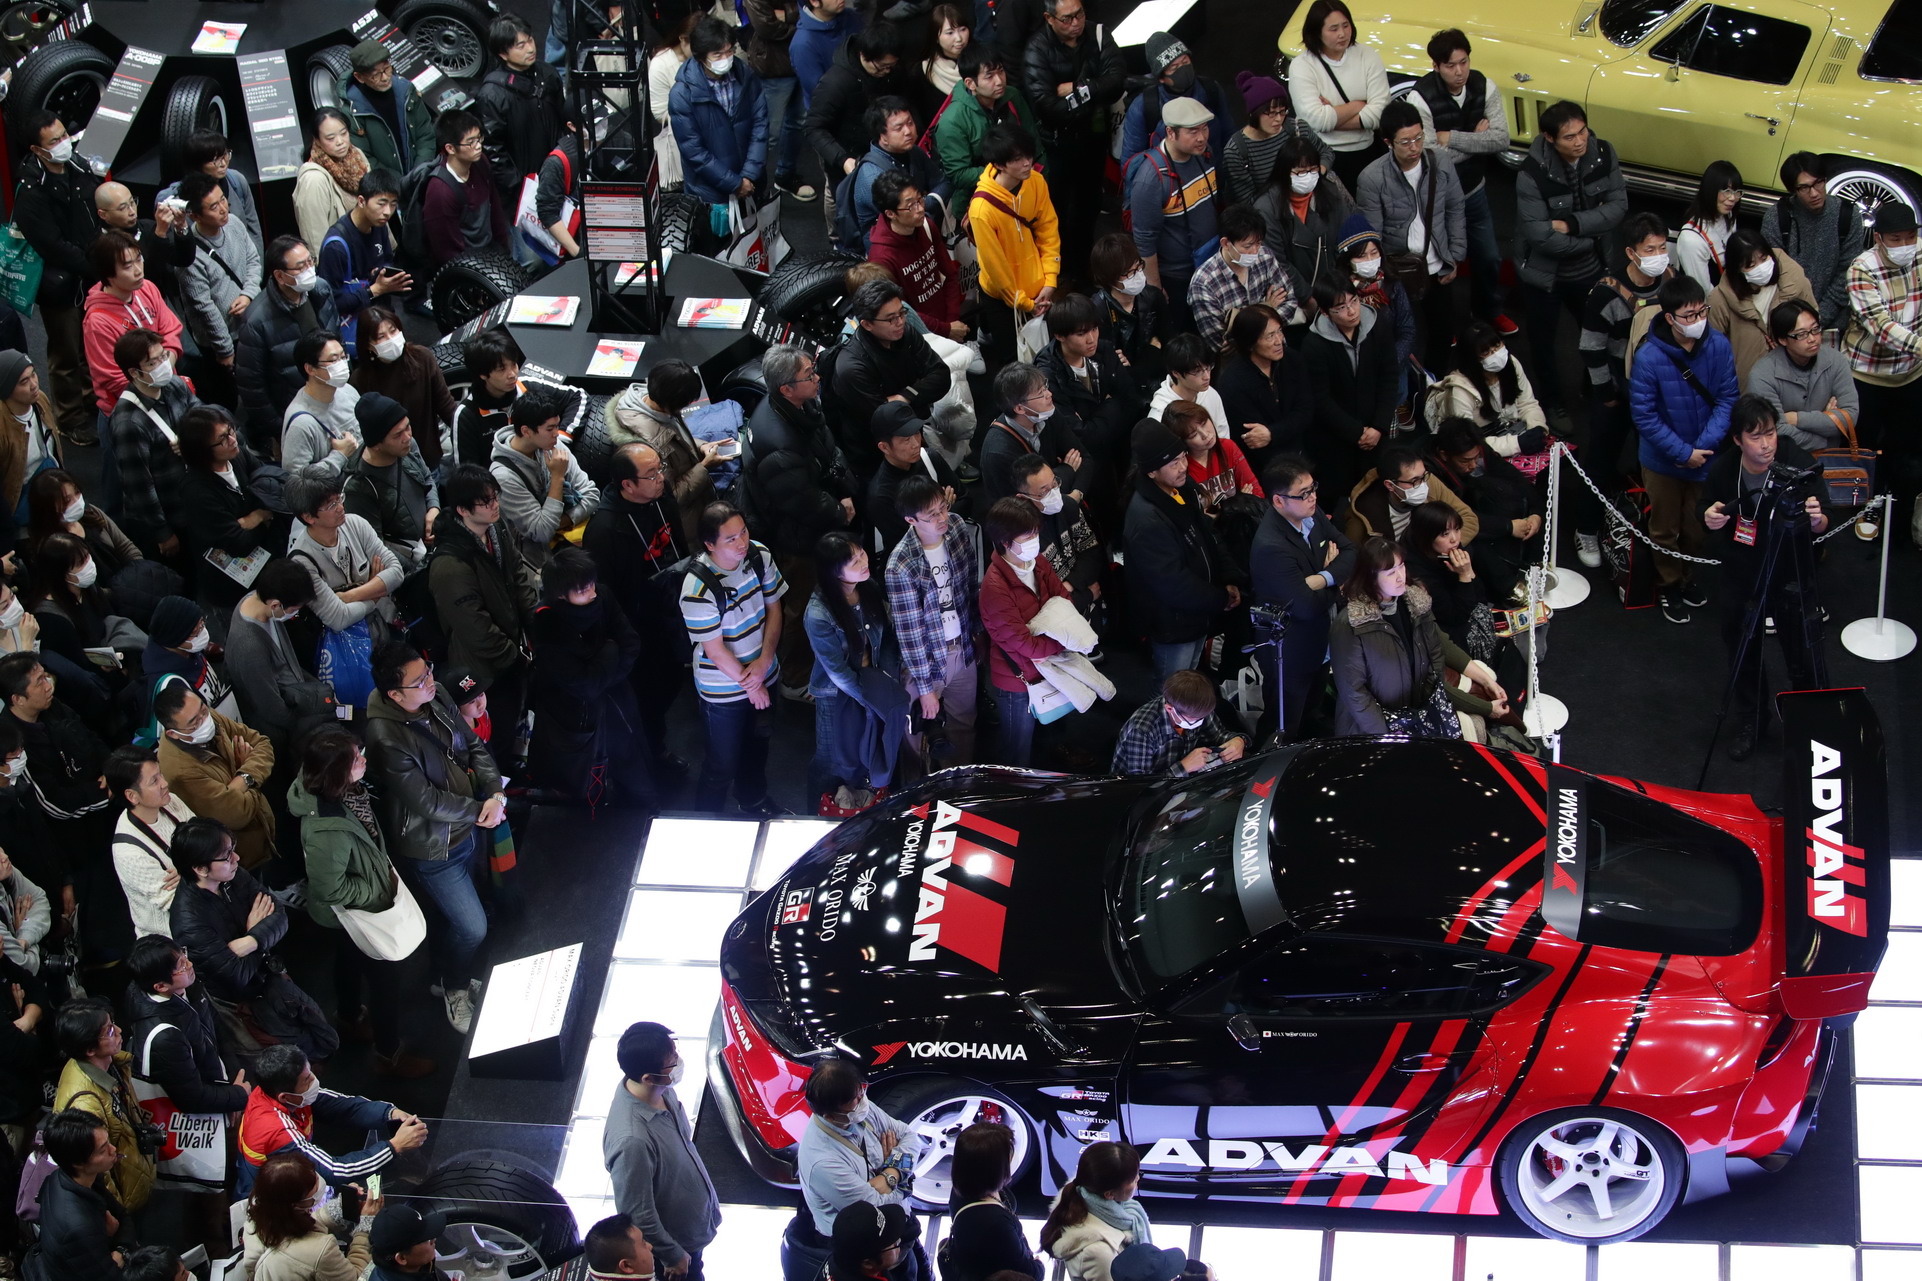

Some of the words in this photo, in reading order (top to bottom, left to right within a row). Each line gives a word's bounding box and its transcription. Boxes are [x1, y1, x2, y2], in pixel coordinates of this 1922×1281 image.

[352, 8, 379, 33] A539
[128, 48, 163, 60] YOKOHAMA
[752, 306, 766, 335] ADVAN
[524, 362, 564, 382] ADVAN
[1556, 788, 1579, 865] YOKOHAMA
[1810, 739, 1845, 917] ADVAN
[897, 819, 924, 878] YOKOHAMA
[1240, 799, 1265, 889] YOKOHAMA
[831, 852, 853, 886] MAX
[908, 800, 962, 962] ADVAN
[783, 891, 803, 923] GR
[820, 889, 844, 942] ORIDO
[729, 1004, 753, 1052] ADVAN
[907, 1040, 1028, 1062] YOKOHAMA
[170, 1113, 219, 1135] Liberty
[177, 1132, 215, 1149] Walk
[1079, 1130, 1109, 1140] HKS
[1139, 1138, 1448, 1186] ADVAN
